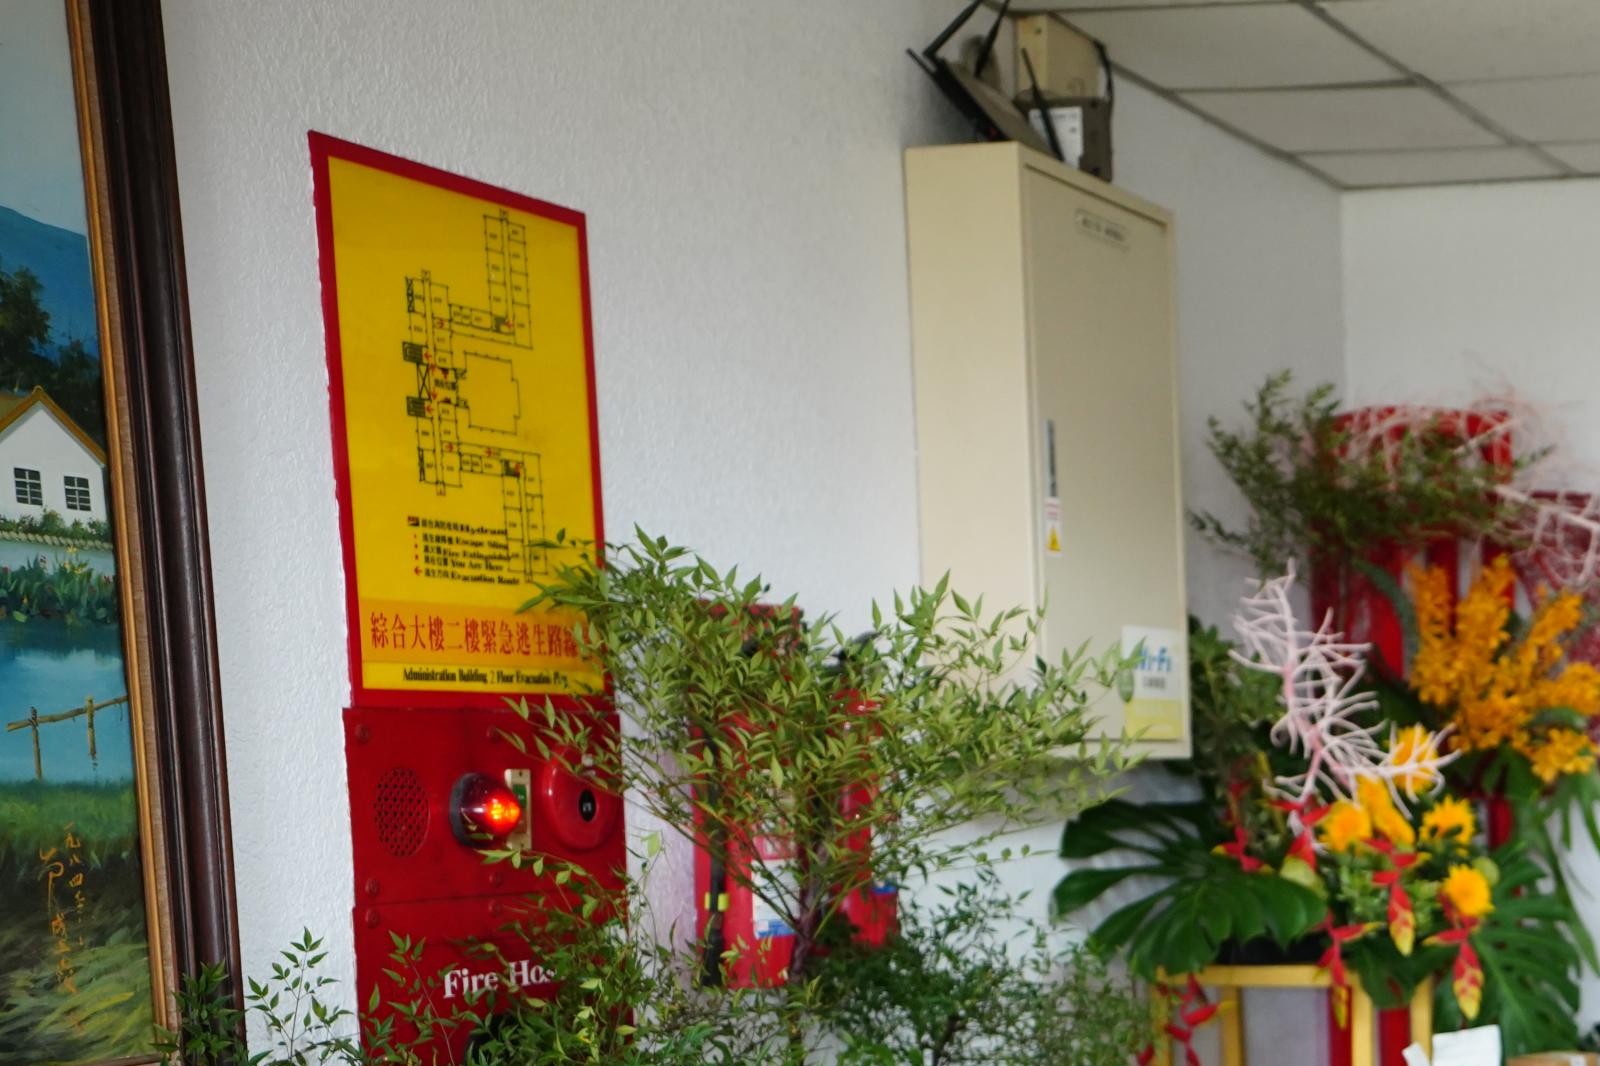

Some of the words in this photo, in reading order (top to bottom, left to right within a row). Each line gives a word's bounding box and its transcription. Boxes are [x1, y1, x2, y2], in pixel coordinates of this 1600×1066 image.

[371, 612, 592, 659] 綜合大樓二樓緊急逃生路線
[402, 667, 456, 682] Administration
[458, 669, 488, 683] Building
[496, 671, 516, 683] Floor
[443, 968, 499, 999] Fire
[508, 958, 564, 990] Hos
